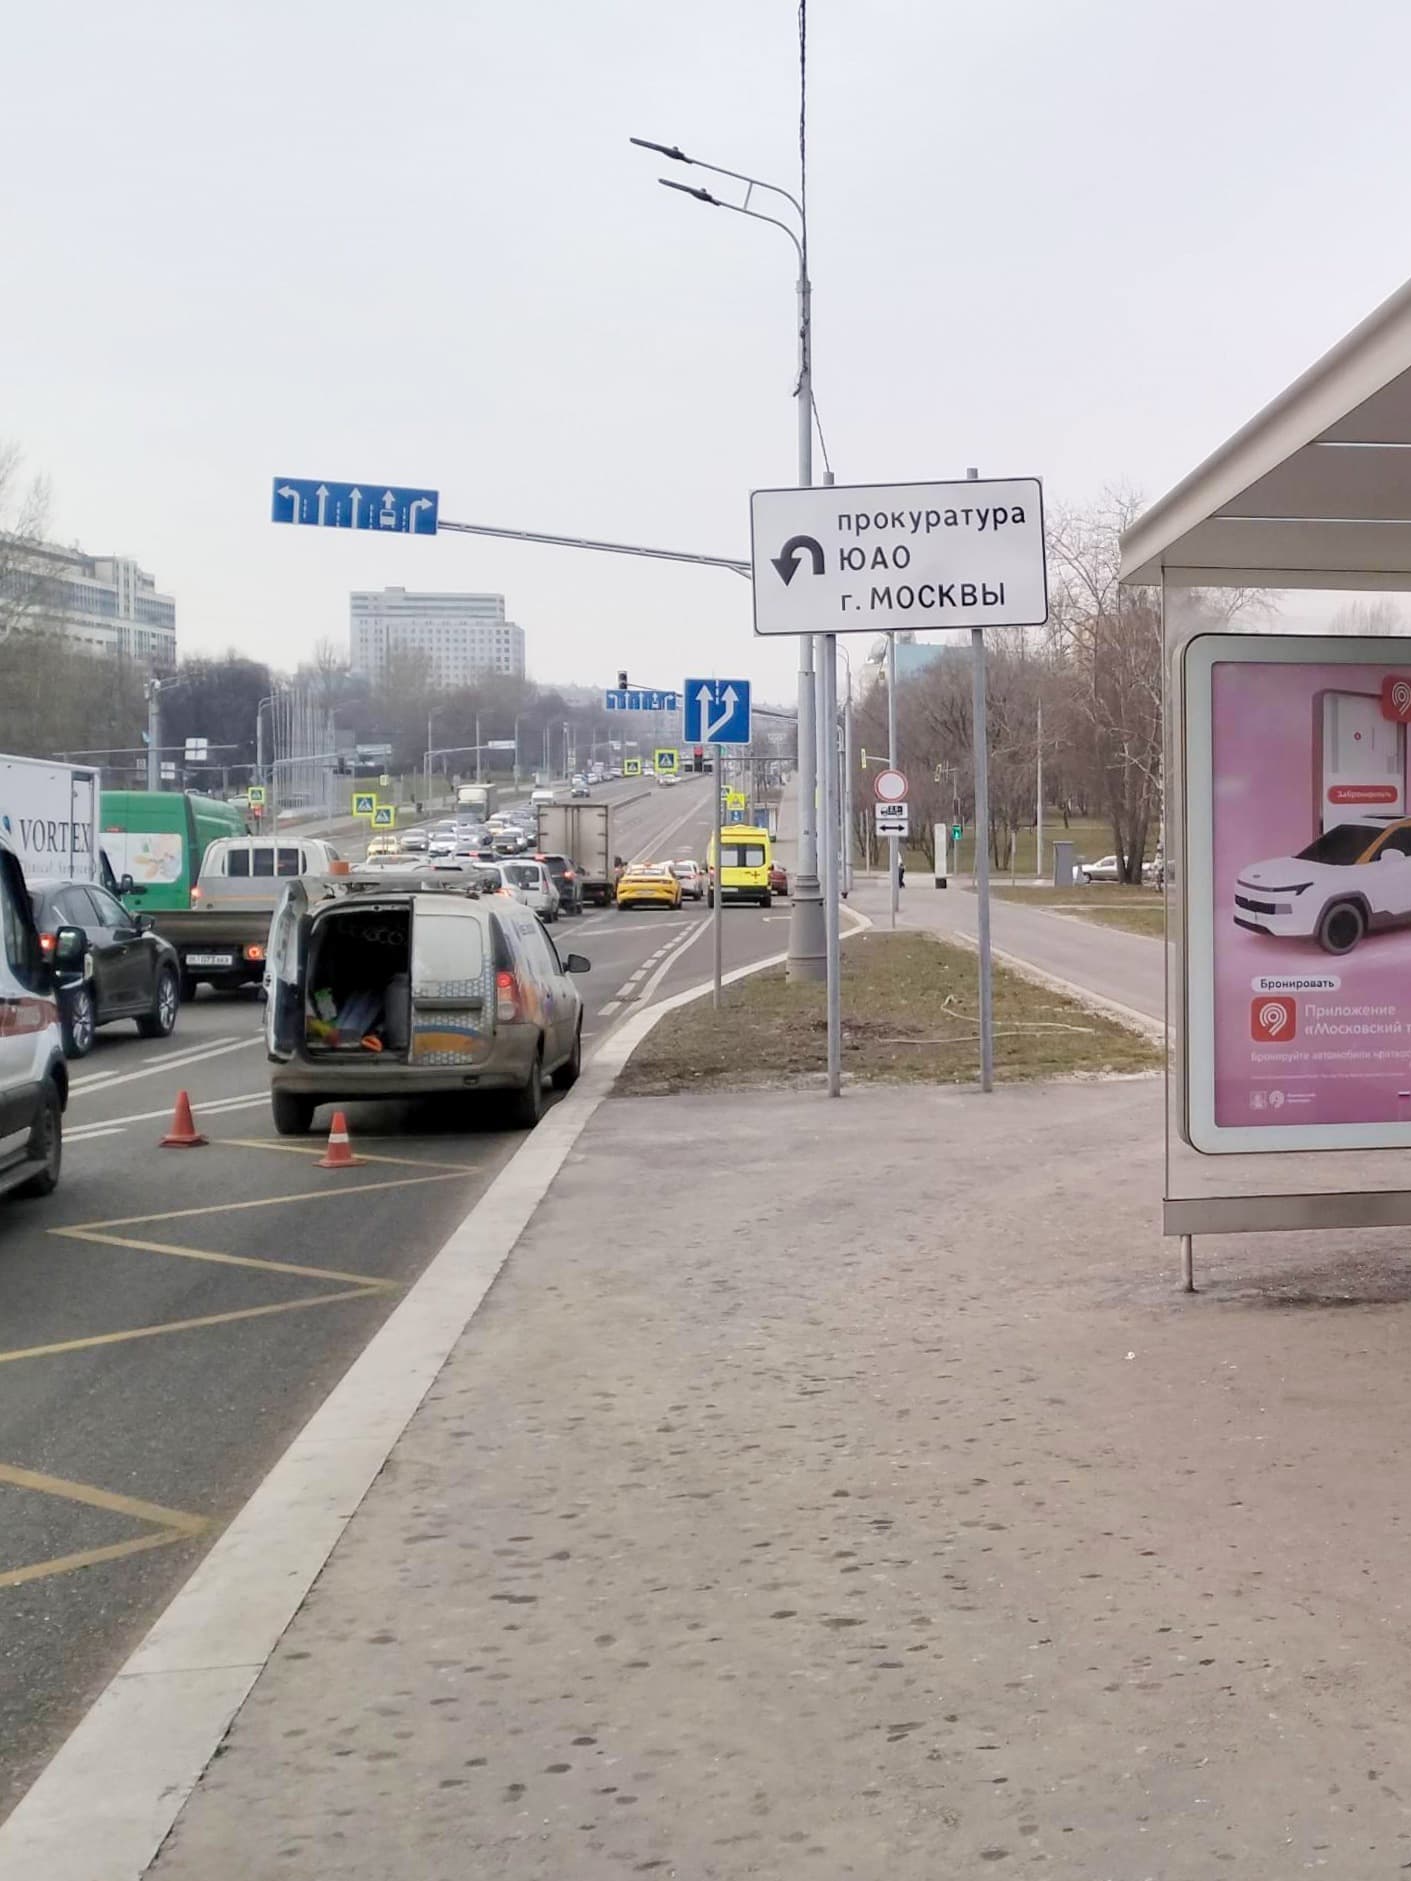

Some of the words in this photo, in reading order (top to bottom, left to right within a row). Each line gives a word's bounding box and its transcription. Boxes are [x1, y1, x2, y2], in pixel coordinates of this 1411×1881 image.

[838, 506, 1026, 537] прокуратура
[839, 545, 911, 571] ЮАО
[841, 594, 861, 611] г.
[870, 582, 1005, 610] МОСКВЫ
[19, 819, 91, 853] VORTEX
[1260, 978, 1335, 989] Бронировать
[1304, 1004, 1396, 1018] Приложение
[1304, 1021, 1402, 1036] «Московский
